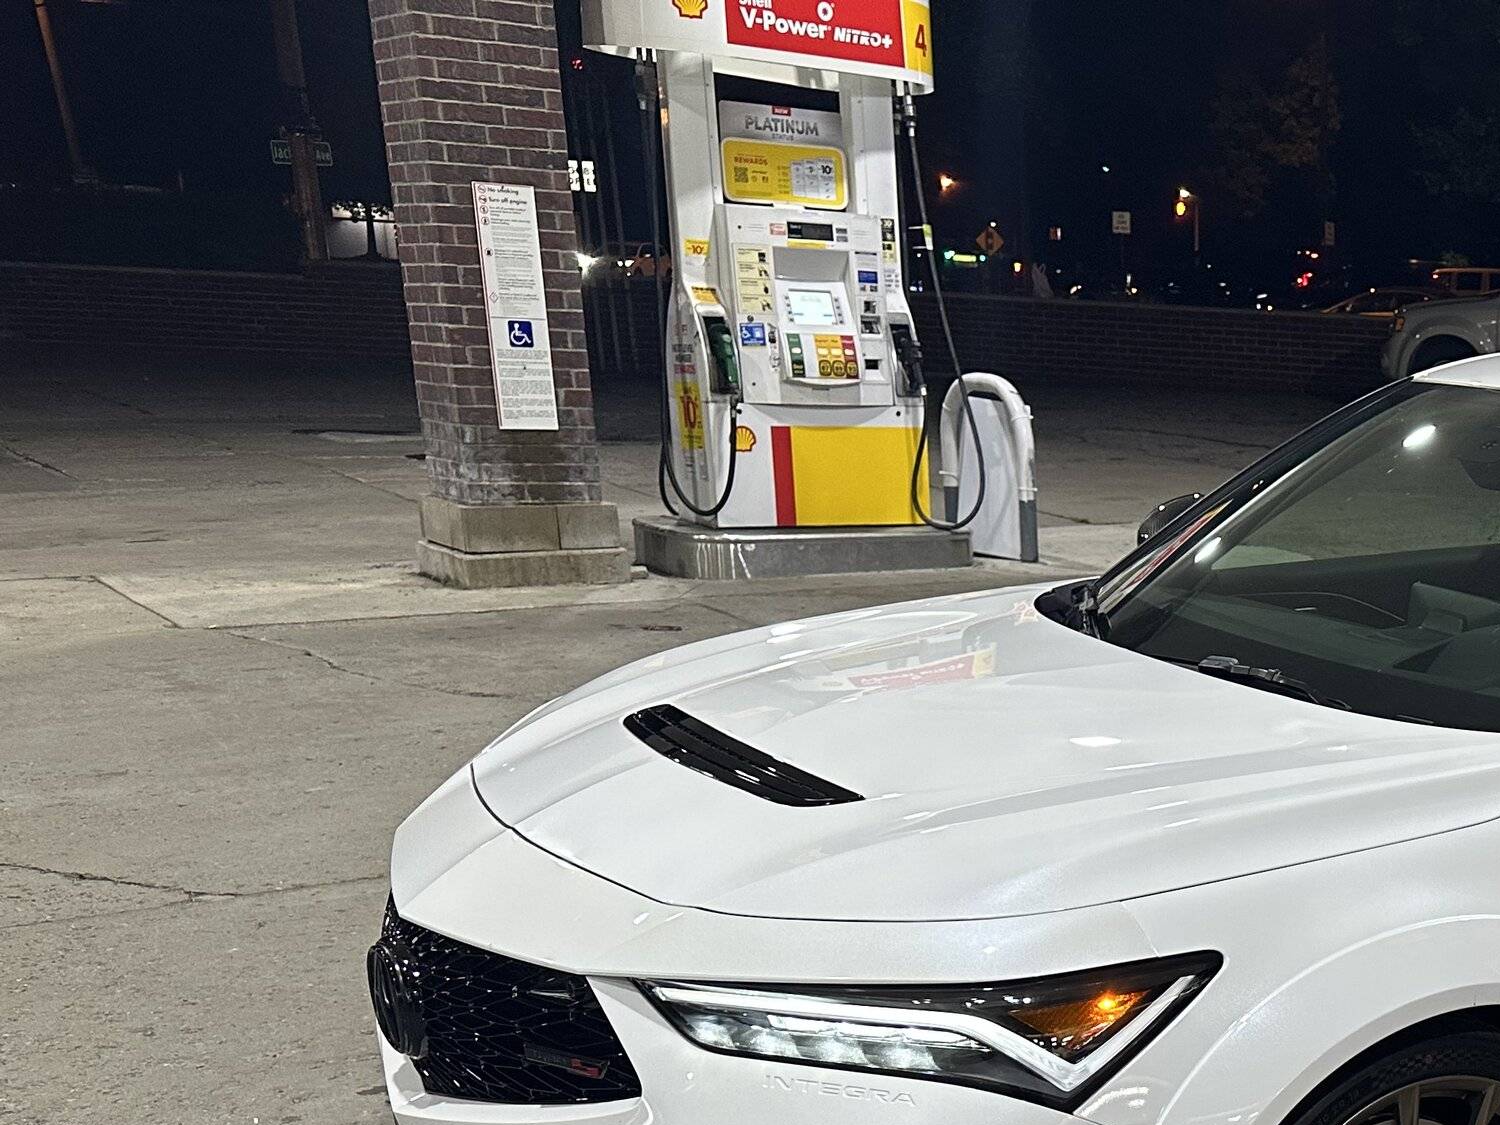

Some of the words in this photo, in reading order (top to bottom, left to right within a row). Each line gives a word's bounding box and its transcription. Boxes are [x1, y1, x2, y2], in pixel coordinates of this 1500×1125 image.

[739, 6, 827, 40] V-Power
[914, 23, 927, 58] 4
[744, 115, 819, 136] PLATINUM
[733, 156, 768, 166] REWARDS
[762, 1074, 917, 1108] INTEGRA
